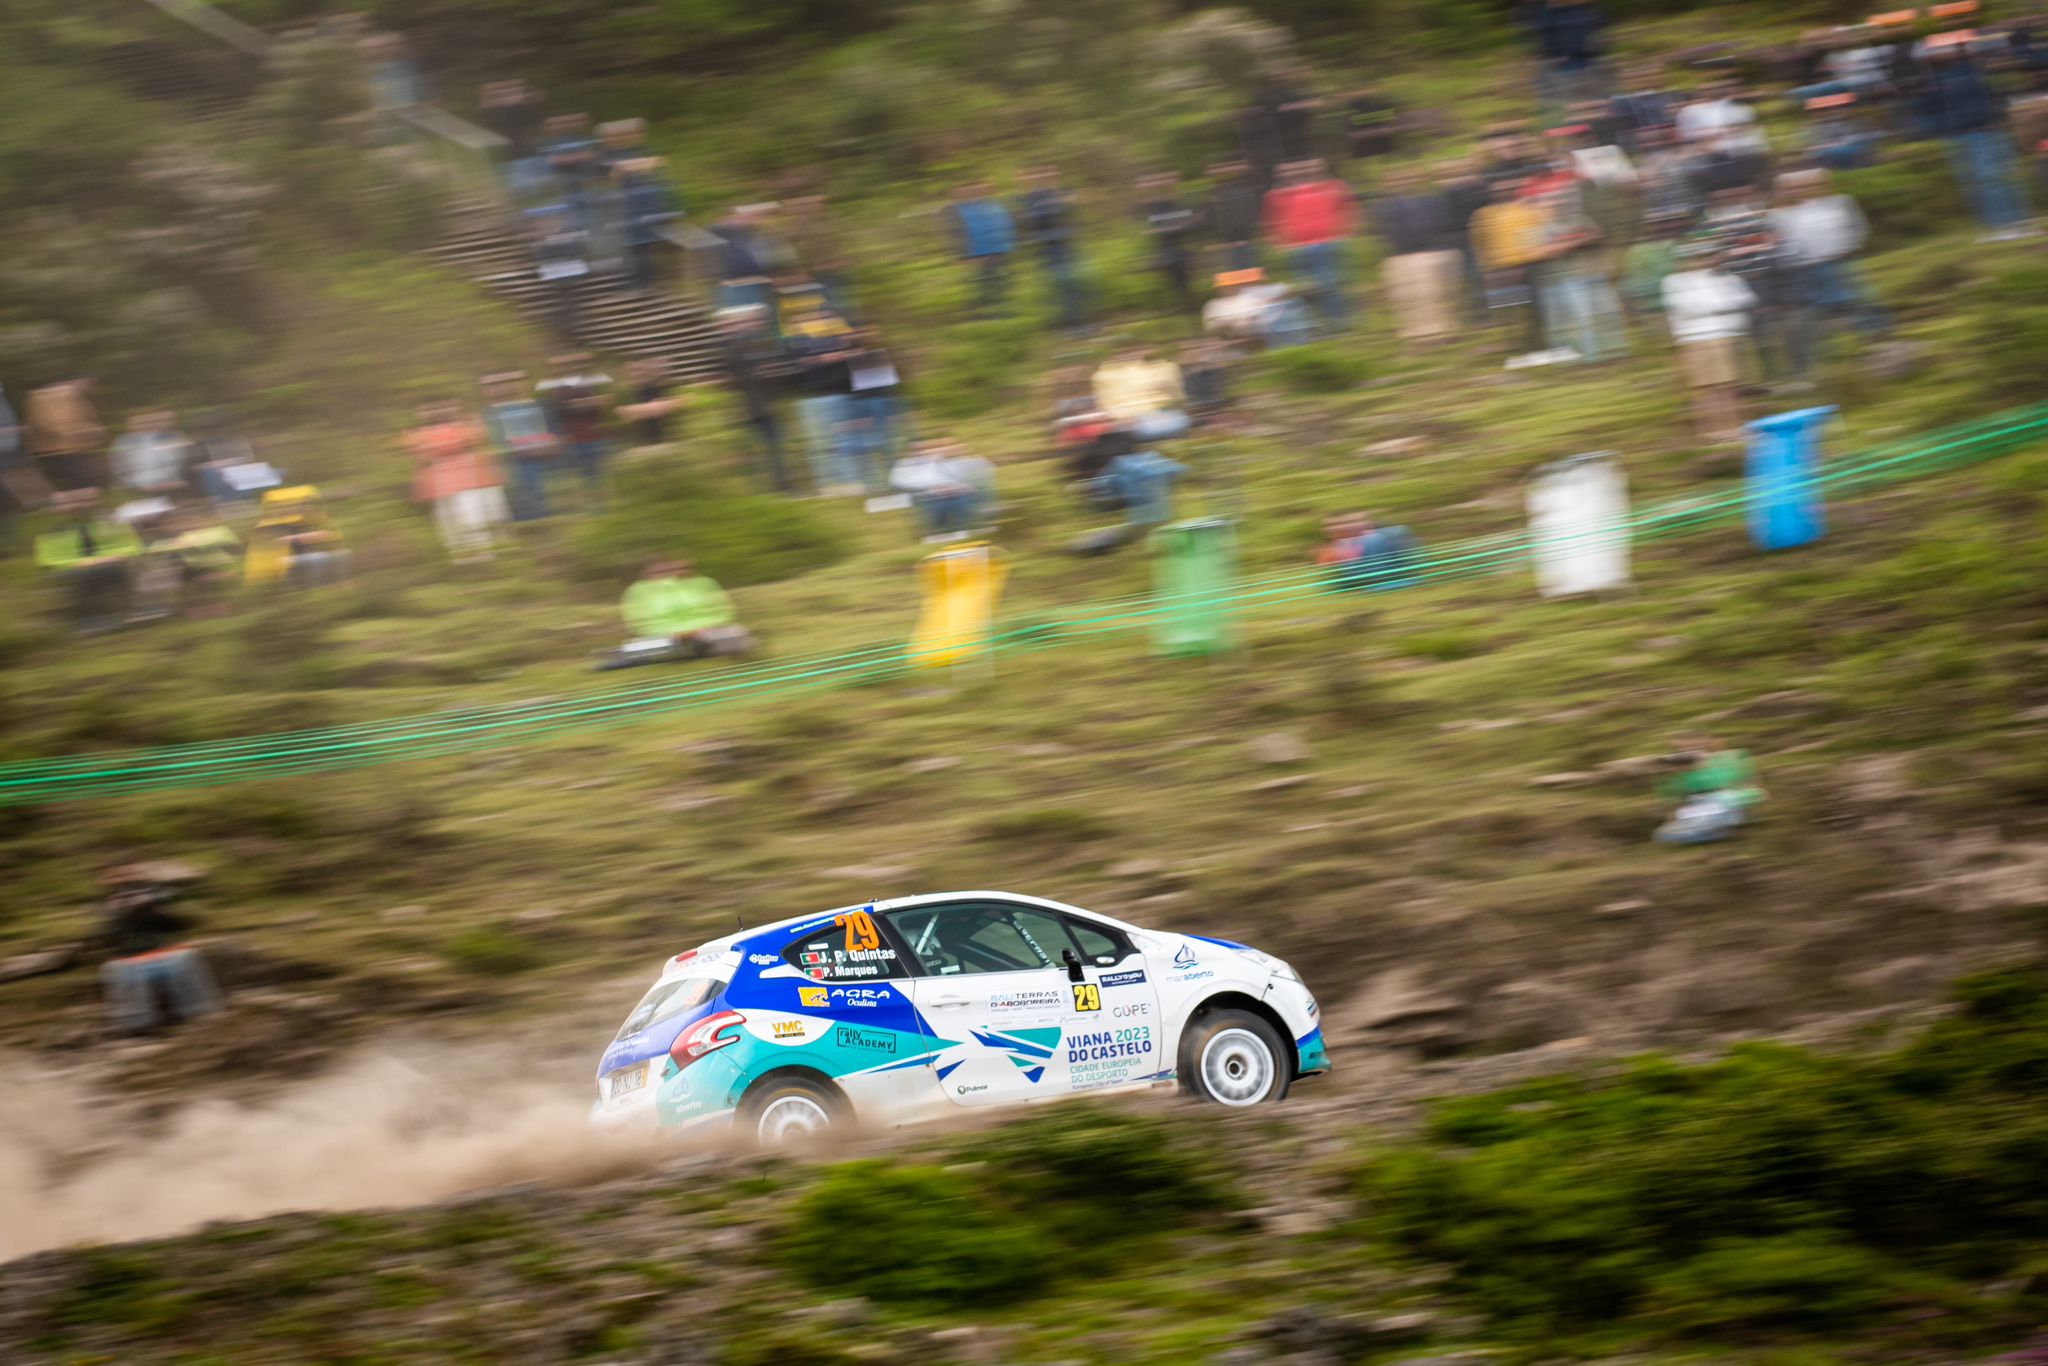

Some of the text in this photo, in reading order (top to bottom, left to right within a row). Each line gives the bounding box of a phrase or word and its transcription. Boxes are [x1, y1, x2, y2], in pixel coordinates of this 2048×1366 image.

[834, 911, 880, 951] 29
[820, 948, 896, 963] J. P. Quintas
[823, 965, 878, 977] P. Marques
[831, 989, 891, 999] AGRA
[1016, 990, 1059, 999] TERRAS
[1074, 984, 1100, 1011] 29
[847, 998, 877, 1008] Oculista
[772, 1020, 803, 1034] VMC
[840, 1028, 861, 1040] rally
[845, 1037, 893, 1050] ACADEMY
[1066, 1026, 1151, 1049] VIANA 2023
[1068, 1040, 1152, 1063] DO CASTELO
[1070, 1057, 1142, 1074] CIDADE EUROPEIA
[1071, 1069, 1128, 1083] DO DESPORTO
